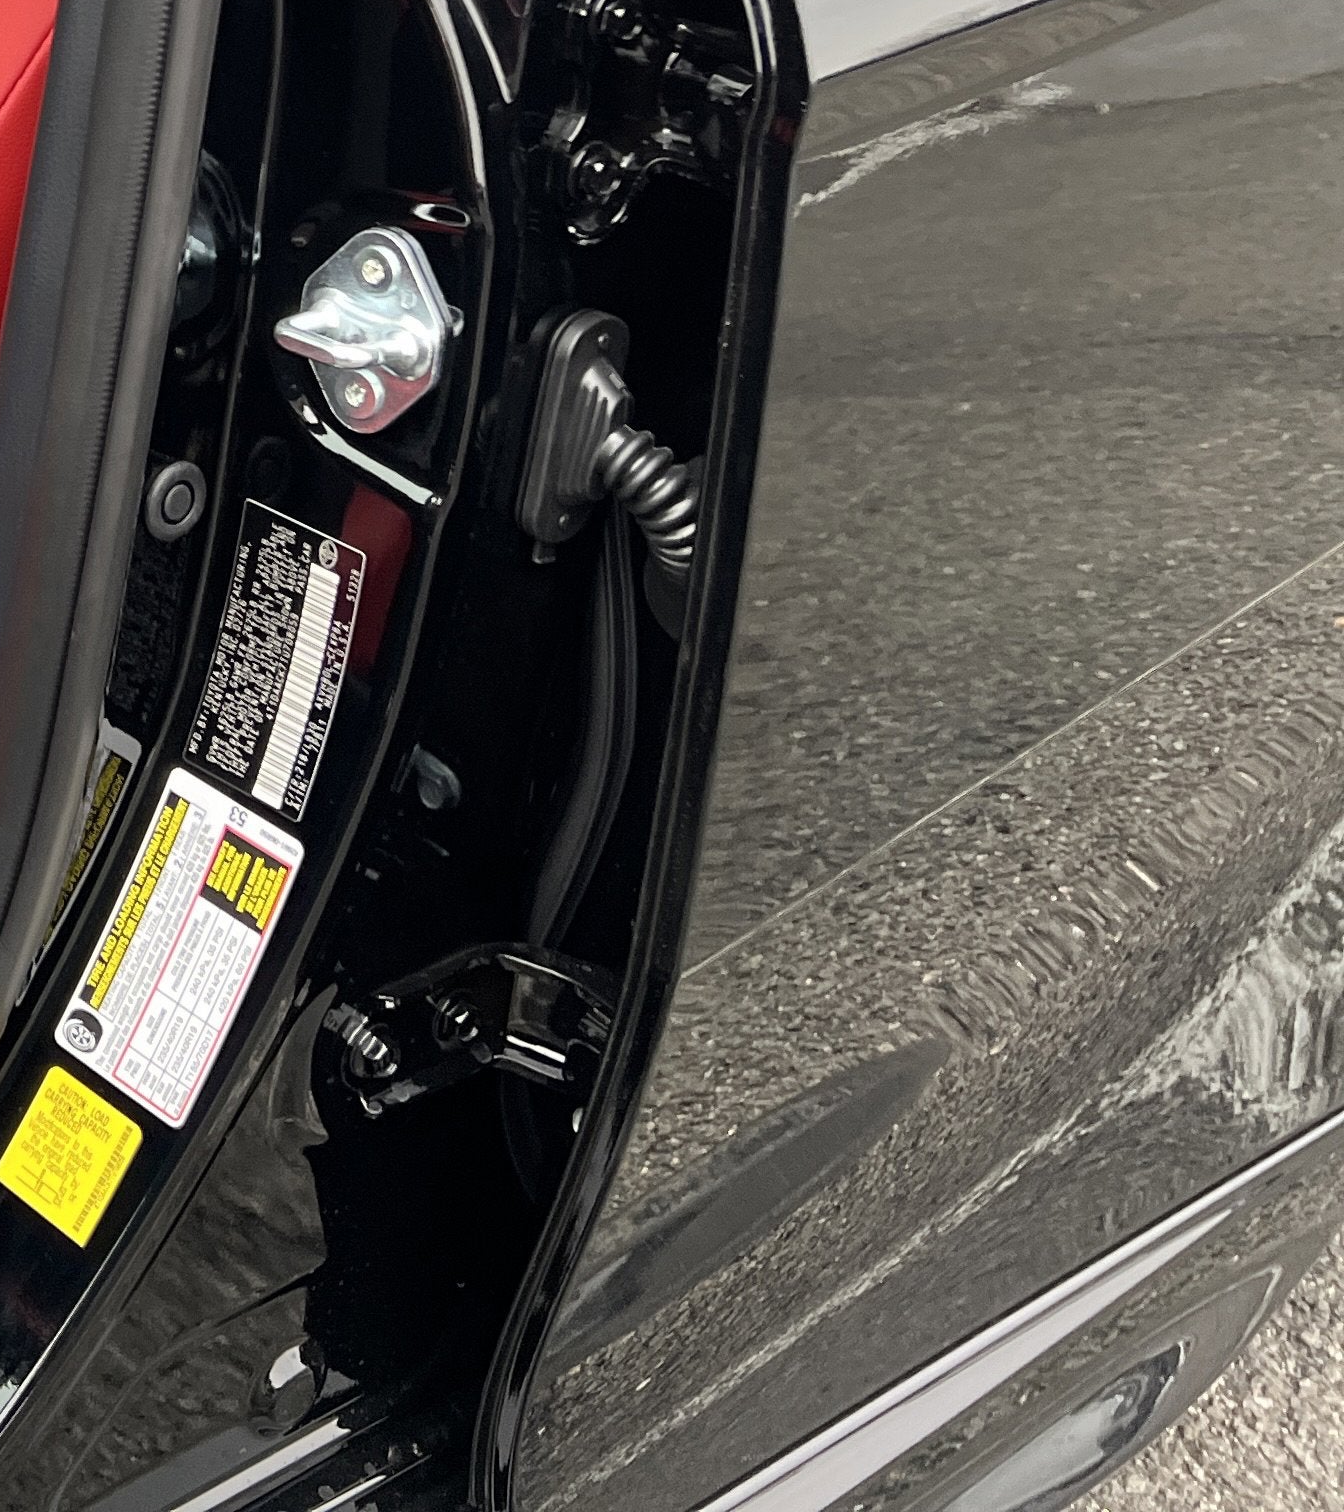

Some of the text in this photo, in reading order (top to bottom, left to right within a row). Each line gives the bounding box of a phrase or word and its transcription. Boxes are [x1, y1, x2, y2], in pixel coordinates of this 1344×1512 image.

[214, 630, 232, 667] MOTOR
[226, 803, 250, 828] 53
[154, 900, 165, 910] 5
[172, 857, 183, 869] 2
[192, 810, 203, 820] 3
[85, 804, 174, 989] TIRE AND LOADING INFORMATION
[202, 985, 217, 1006] 240
[42, 1086, 112, 1144] CARRYING CAPACITY
[49, 1105, 82, 1135] REDUCED
[88, 1106, 110, 1128] LOAD
